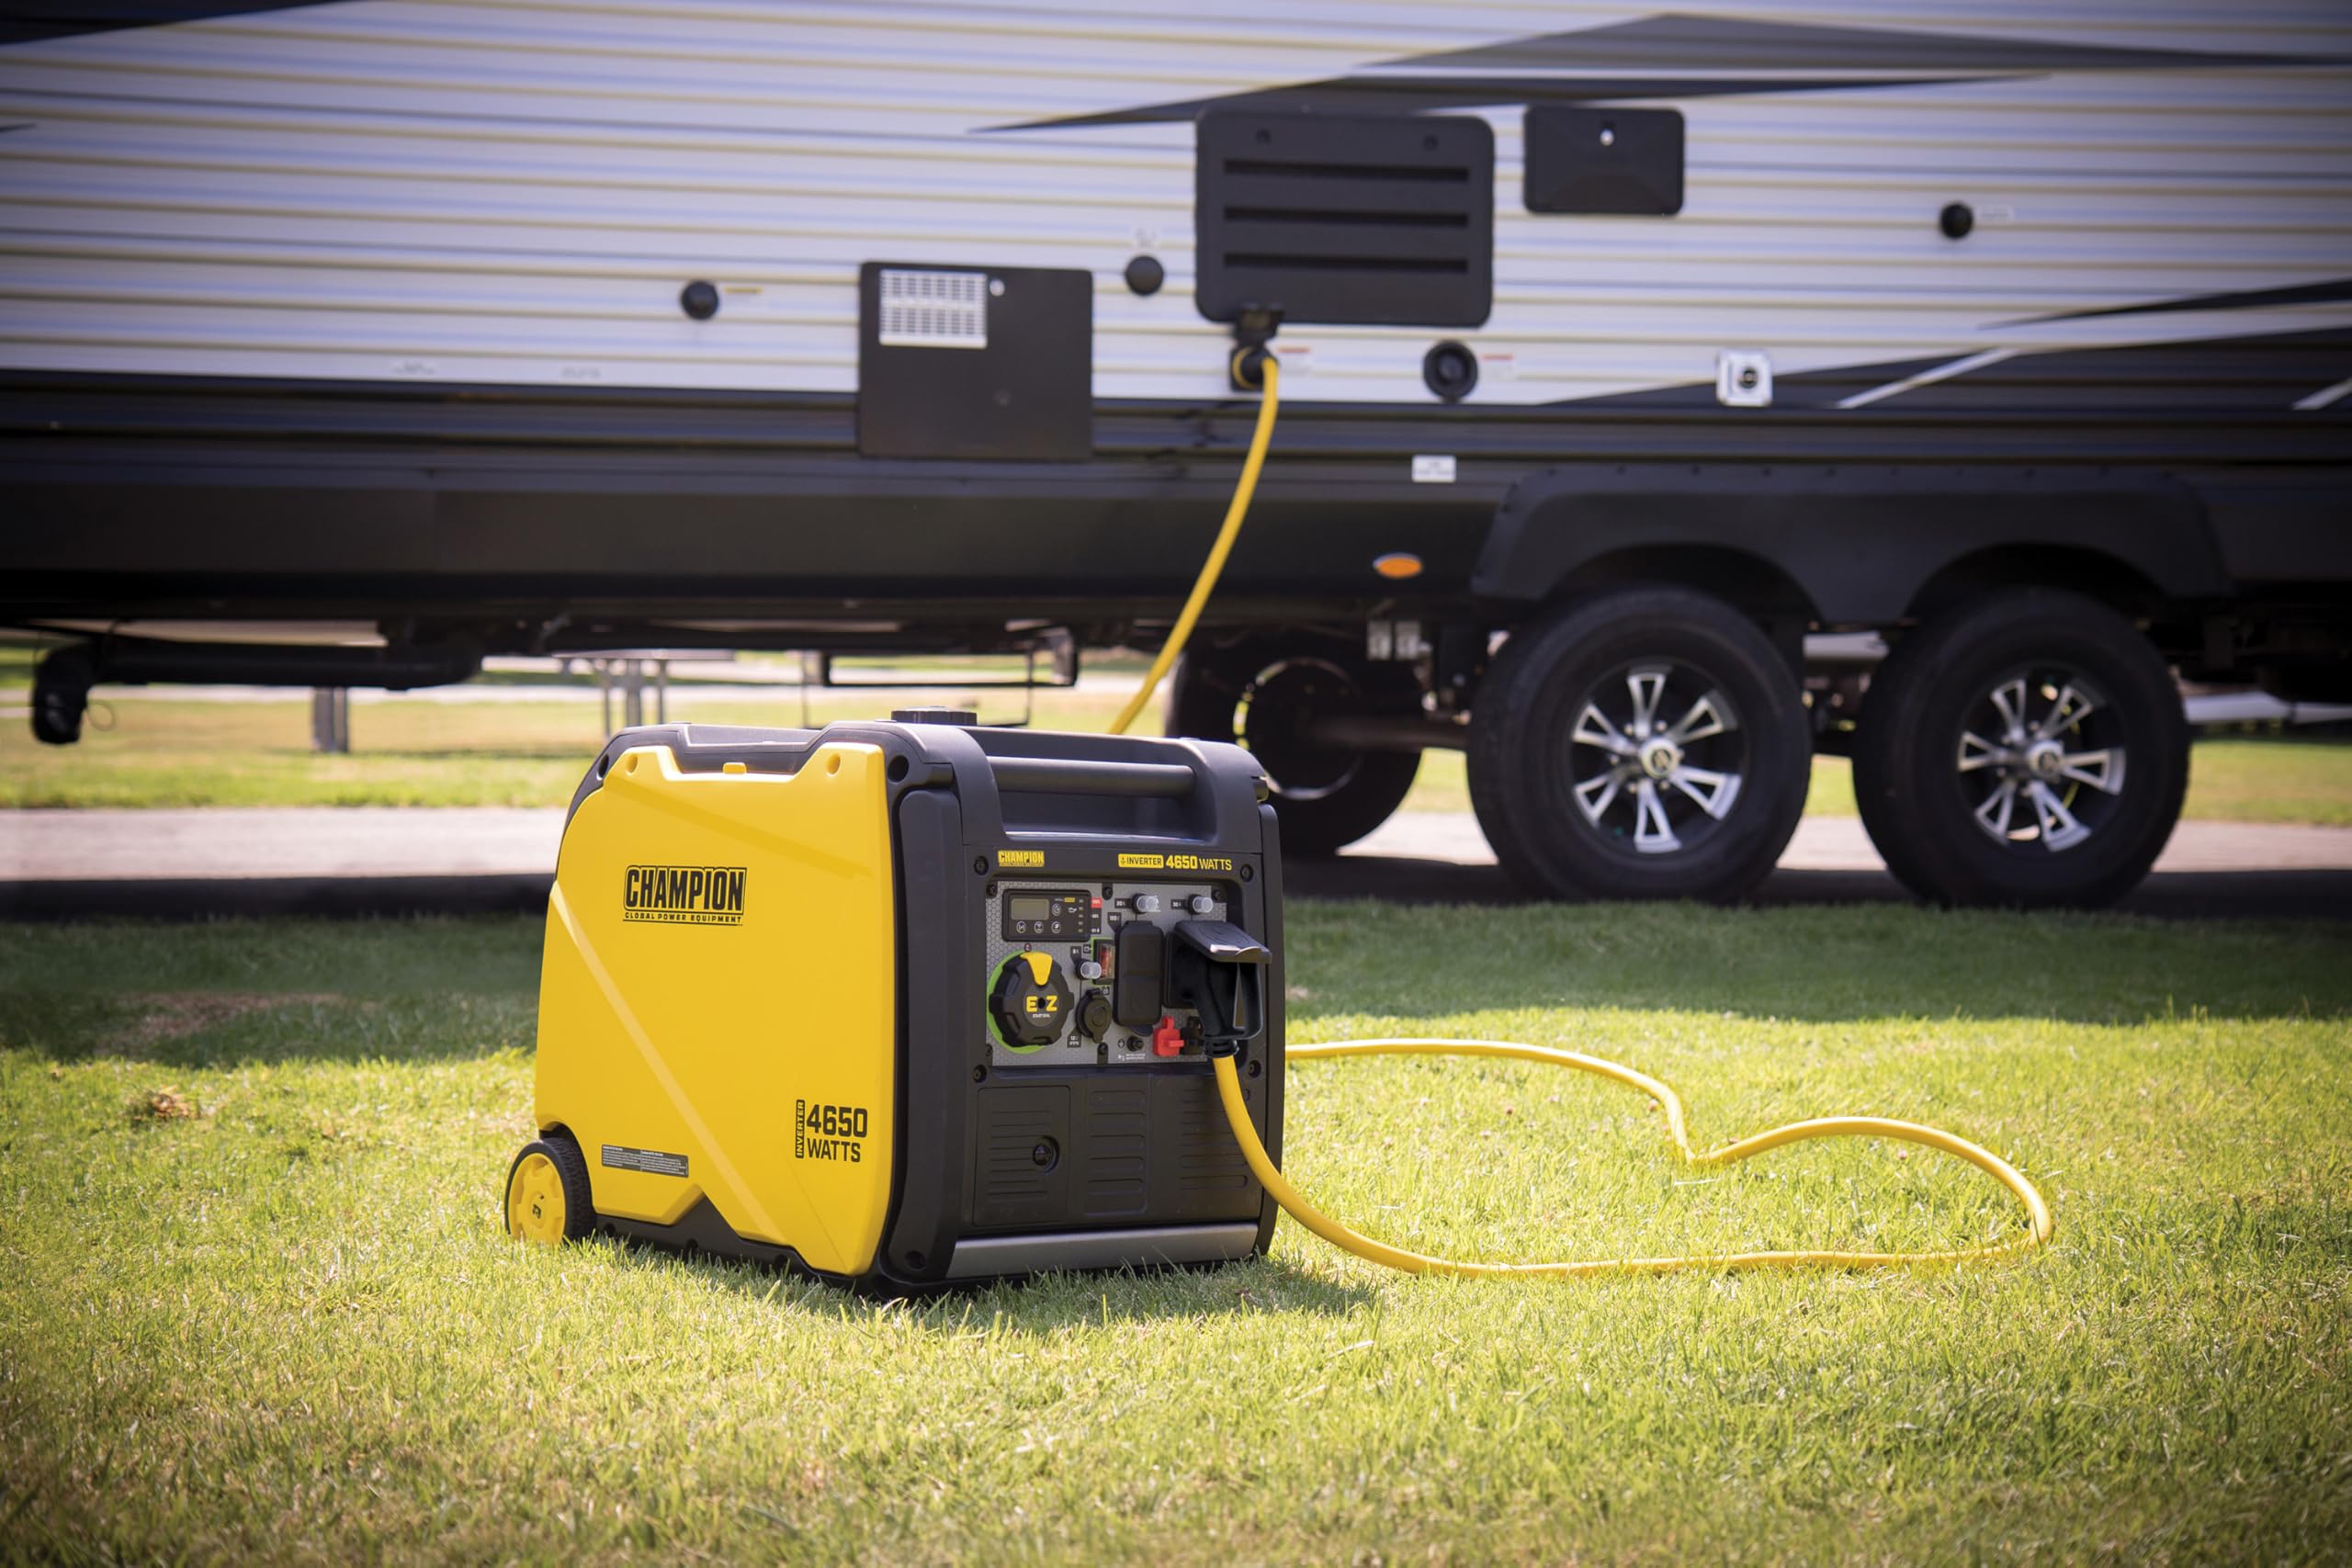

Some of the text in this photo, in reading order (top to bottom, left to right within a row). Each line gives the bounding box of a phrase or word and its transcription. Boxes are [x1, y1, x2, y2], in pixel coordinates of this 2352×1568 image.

[998, 851, 1045, 863] CHAMPION
[1126, 854, 1232, 871] INVERTER 4650 WATTS
[626, 868, 744, 911] CHAMPION
[691, 914, 741, 923] EQUIPMENT
[797, 1101, 805, 1156] INVERTER
[807, 1104, 868, 1138] 4650
[807, 1137, 861, 1163] WATTS
